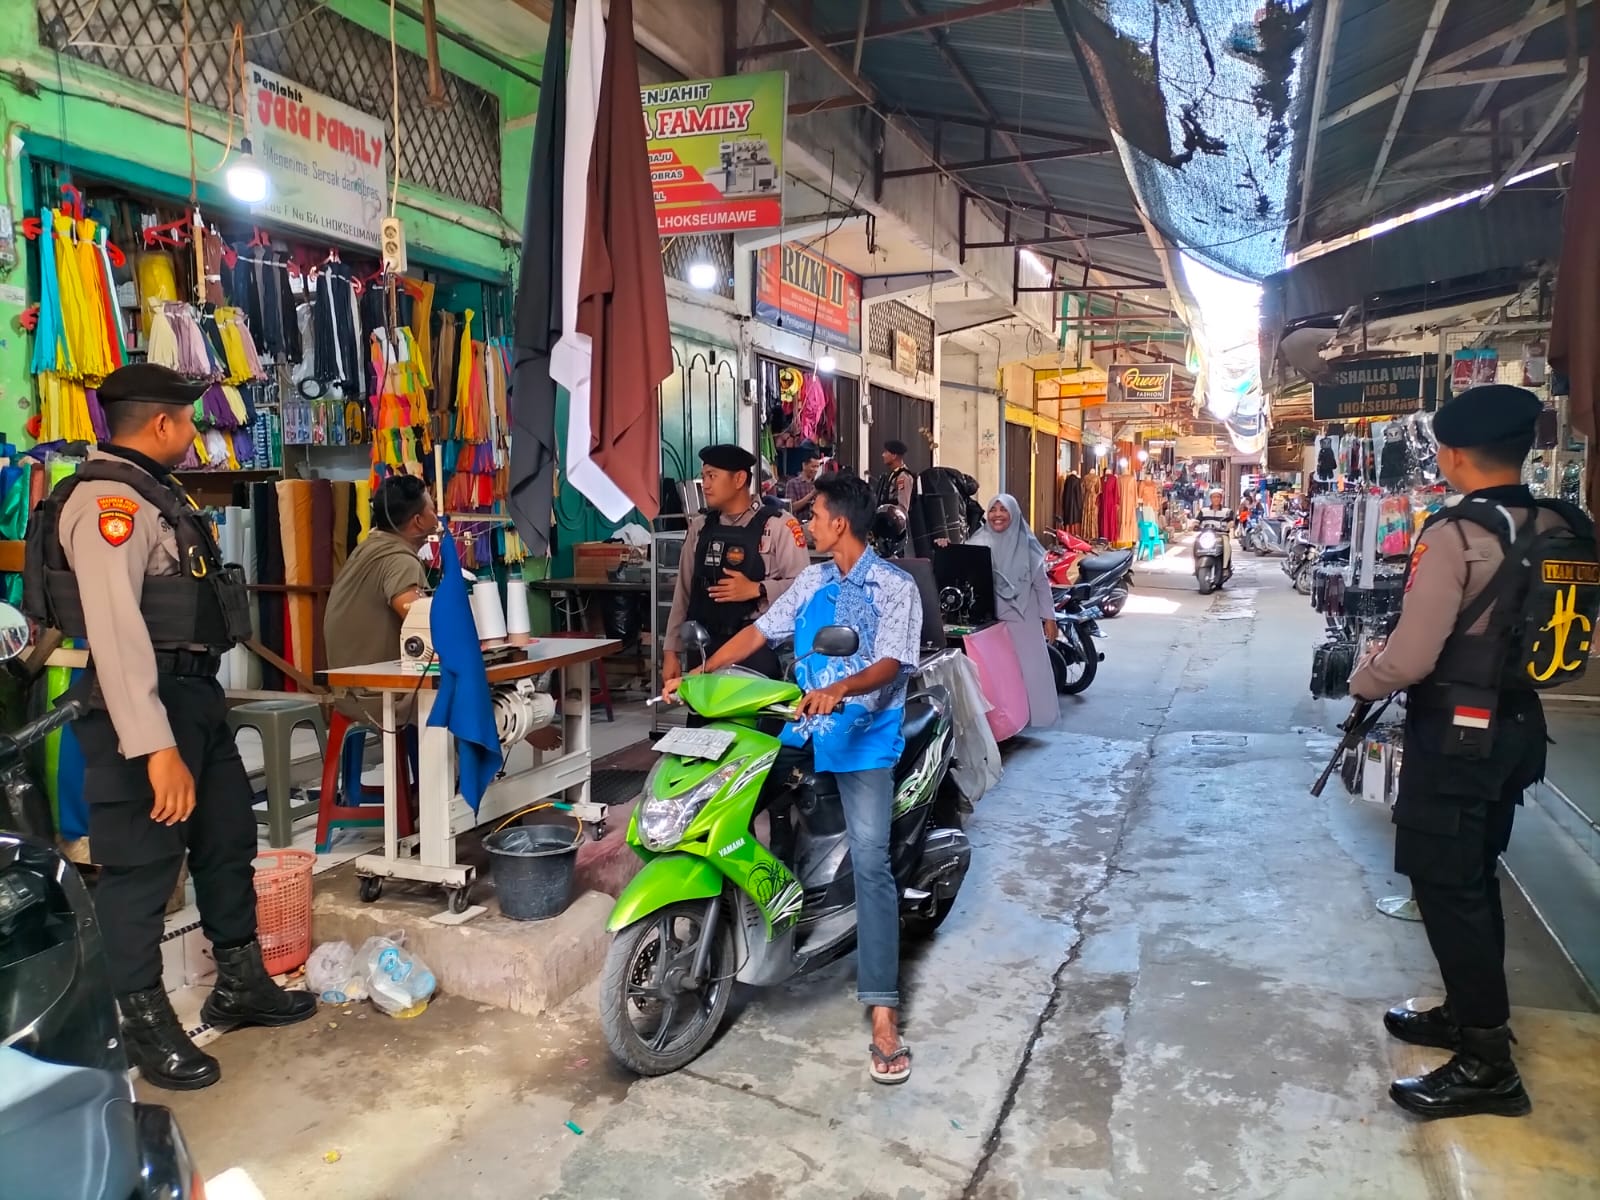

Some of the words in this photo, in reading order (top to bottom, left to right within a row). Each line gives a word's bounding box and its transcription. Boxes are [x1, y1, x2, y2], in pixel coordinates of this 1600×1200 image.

[253, 71, 303, 103] Penjahit
[640, 84, 711, 105] ENJAHIT
[658, 103, 751, 137] FAMILY
[651, 170, 683, 181] OBRAS
[654, 191, 665, 201] LL
[657, 210, 757, 228] LHOKSEUMAWE
[781, 244, 828, 300] RIZKI
[1121, 367, 1168, 392] Queen
[1392, 364, 1438, 381] WANIT
[1365, 384, 1387, 397] LOS
[1389, 382, 1398, 395] B
[717, 837, 746, 857] YAMAHA
